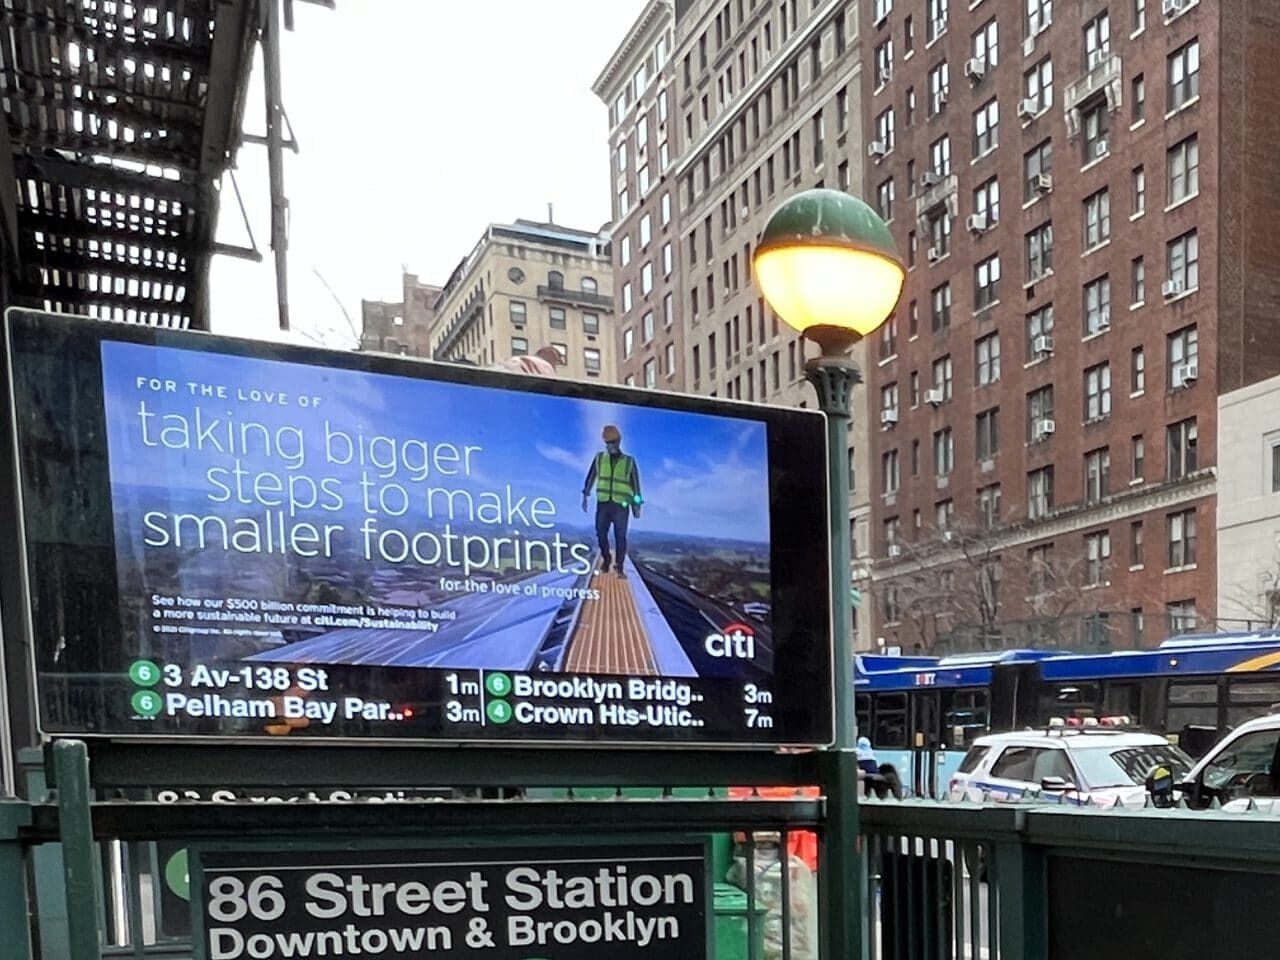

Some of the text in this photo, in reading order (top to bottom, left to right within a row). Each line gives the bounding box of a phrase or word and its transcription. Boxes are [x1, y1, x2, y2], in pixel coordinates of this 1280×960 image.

[136, 377, 322, 408] FOR THE LOVE OF
[137, 400, 483, 482] taking bigger
[206, 459, 557, 529] steps to make
[143, 509, 601, 577] smaller footprints.
[440, 577, 601, 602] for the love of progress
[152, 594, 456, 621] See how our $500 billion commitment is helping to build
[152, 609, 161, 619] a
[163, 609, 194, 620] more
[196, 610, 261, 623] sustainable
[263, 612, 298, 624] future
[300, 614, 312, 625] at
[704, 628, 756, 660] citi
[138, 663, 480, 696] 6 3 Av-138 St 1m
[492, 676, 504, 692] 6
[514, 675, 624, 704] Brooklyn
[744, 683, 773, 704] 3m
[140, 695, 154, 710] 6
[166, 692, 276, 719] Pelham
[284, 696, 338, 724] Bay
[446, 701, 480, 724] 3m
[493, 705, 505, 720] 4
[514, 702, 594, 725] Crown
[744, 708, 774, 729] 7m
[208, 865, 694, 922] 86 Street Station
[208, 911, 680, 960] Downtown & Brooklyn
